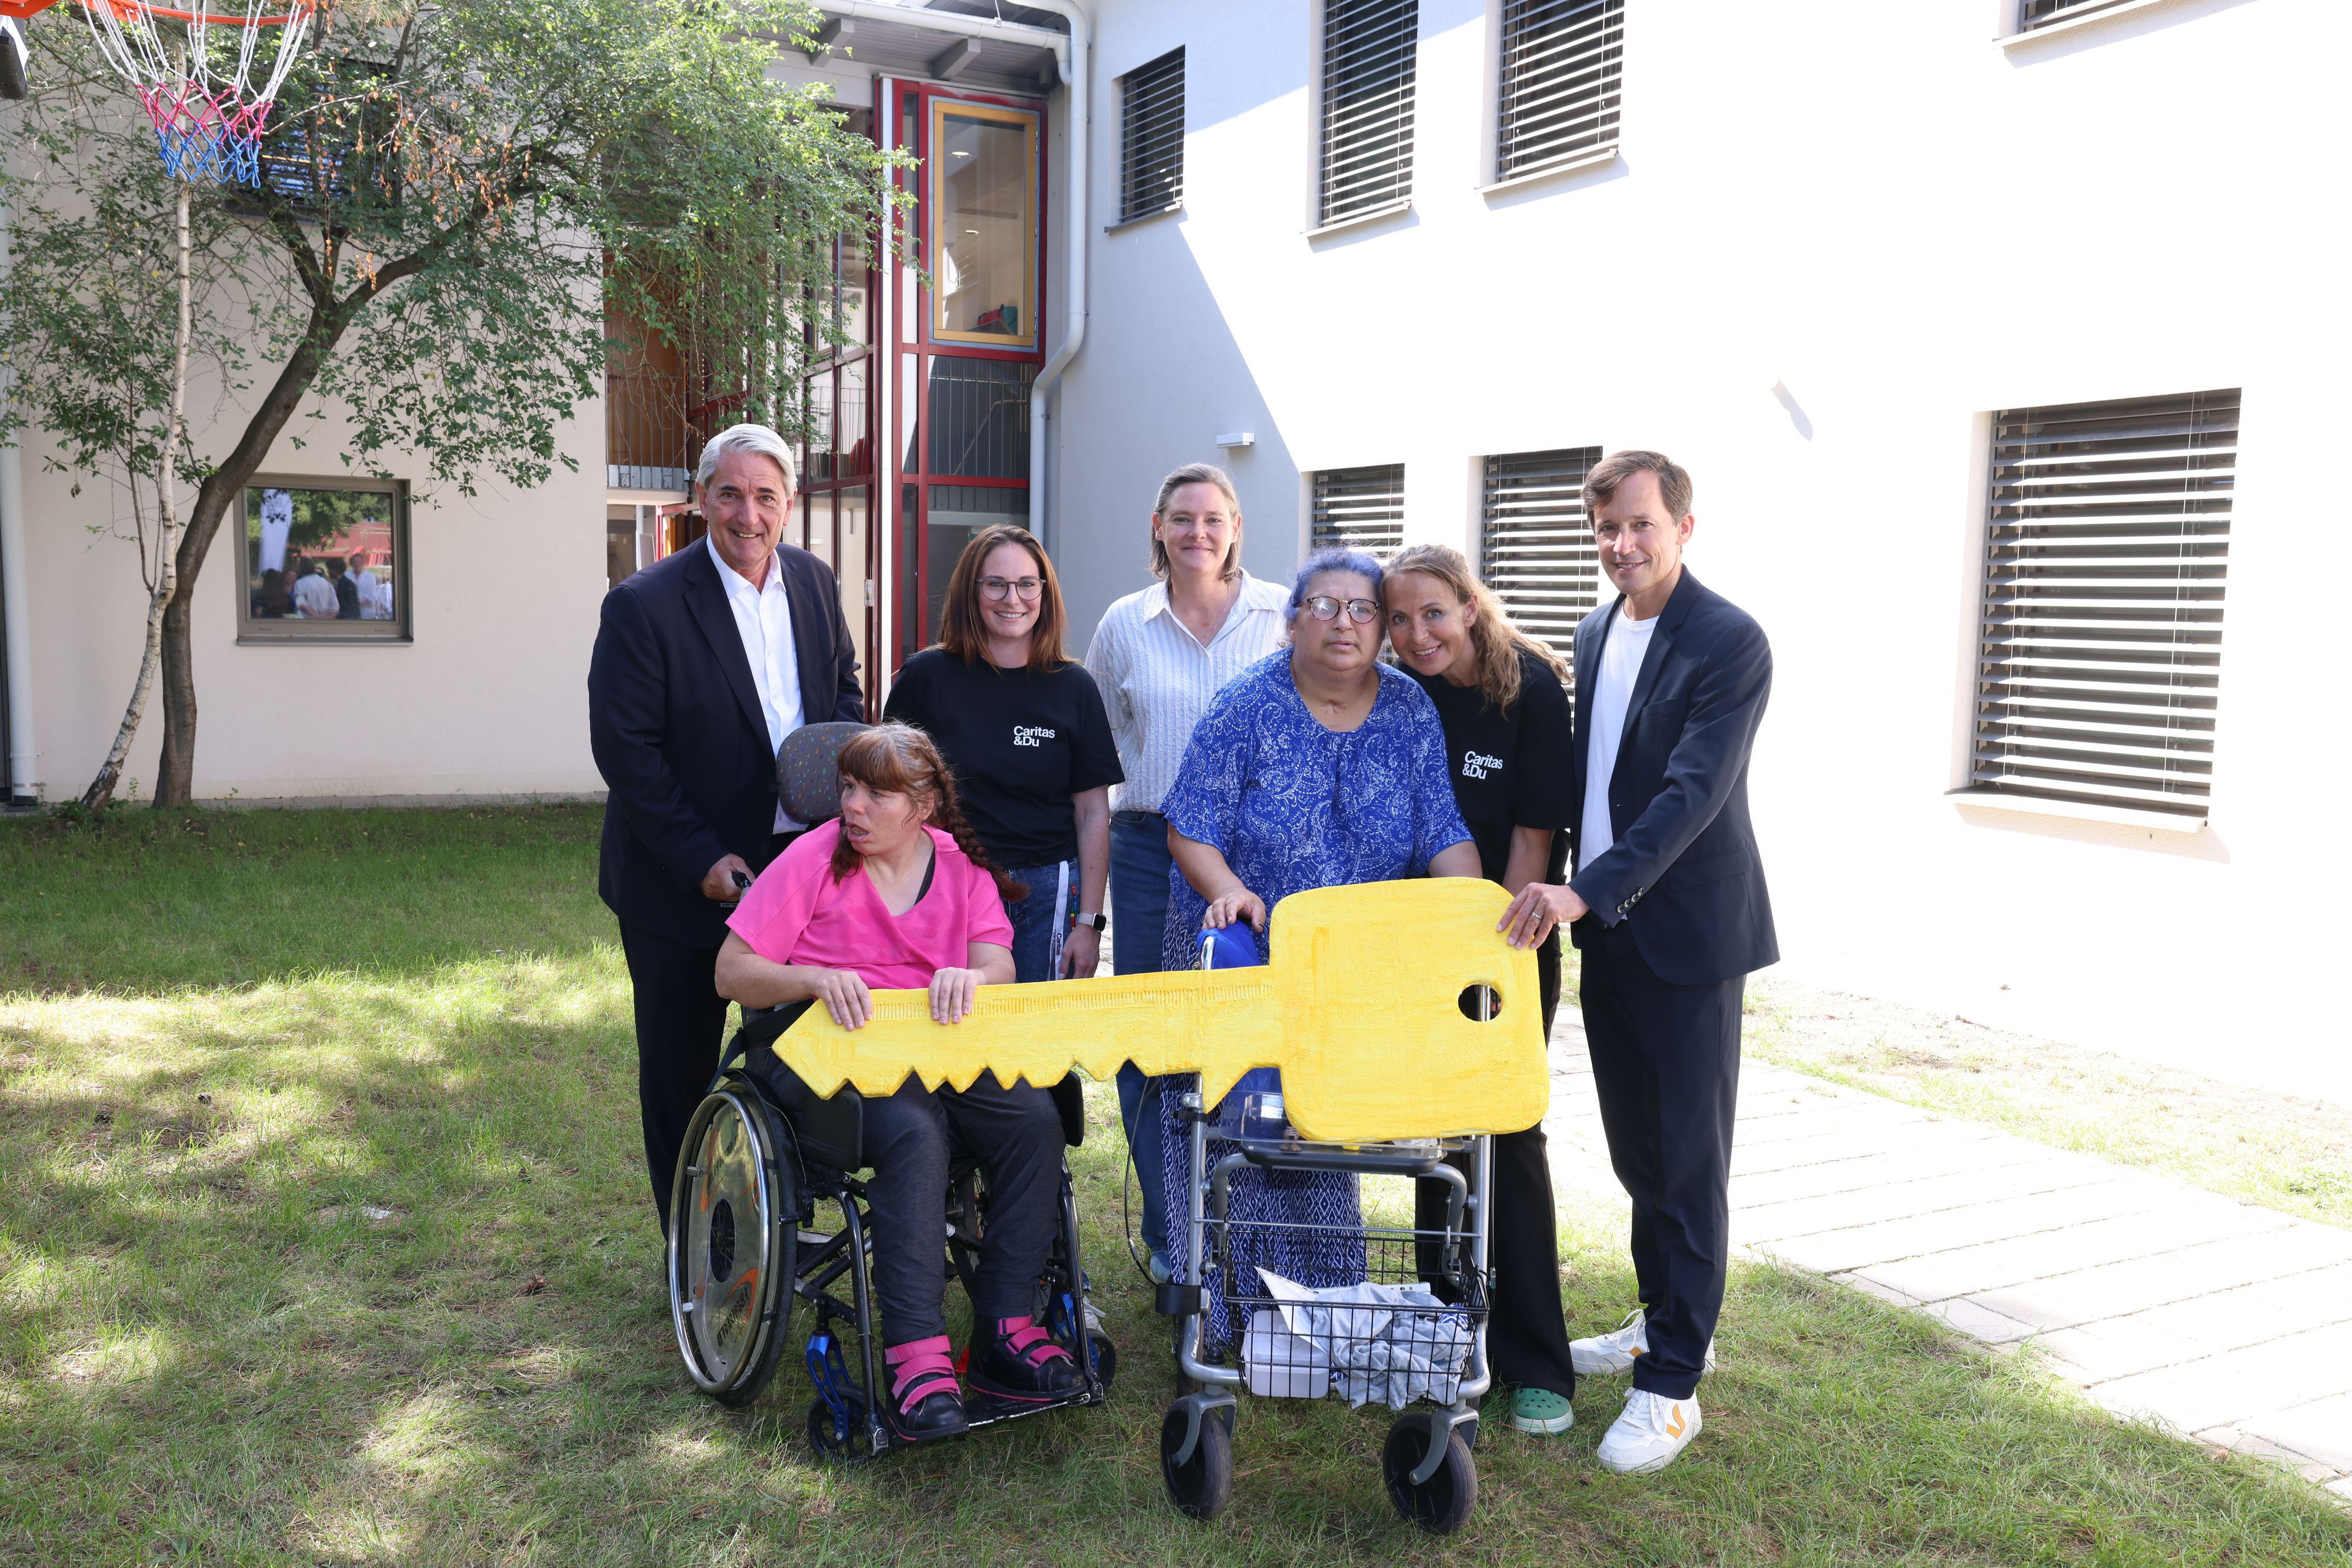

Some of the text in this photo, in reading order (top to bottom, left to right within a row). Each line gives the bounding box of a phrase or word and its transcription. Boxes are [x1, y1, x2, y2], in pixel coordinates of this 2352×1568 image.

[1013, 726, 1055, 738] Caritas
[1013, 736, 1040, 747] &Du
[1464, 751, 1504, 769] Caritas
[1462, 763, 1488, 780] &Du
